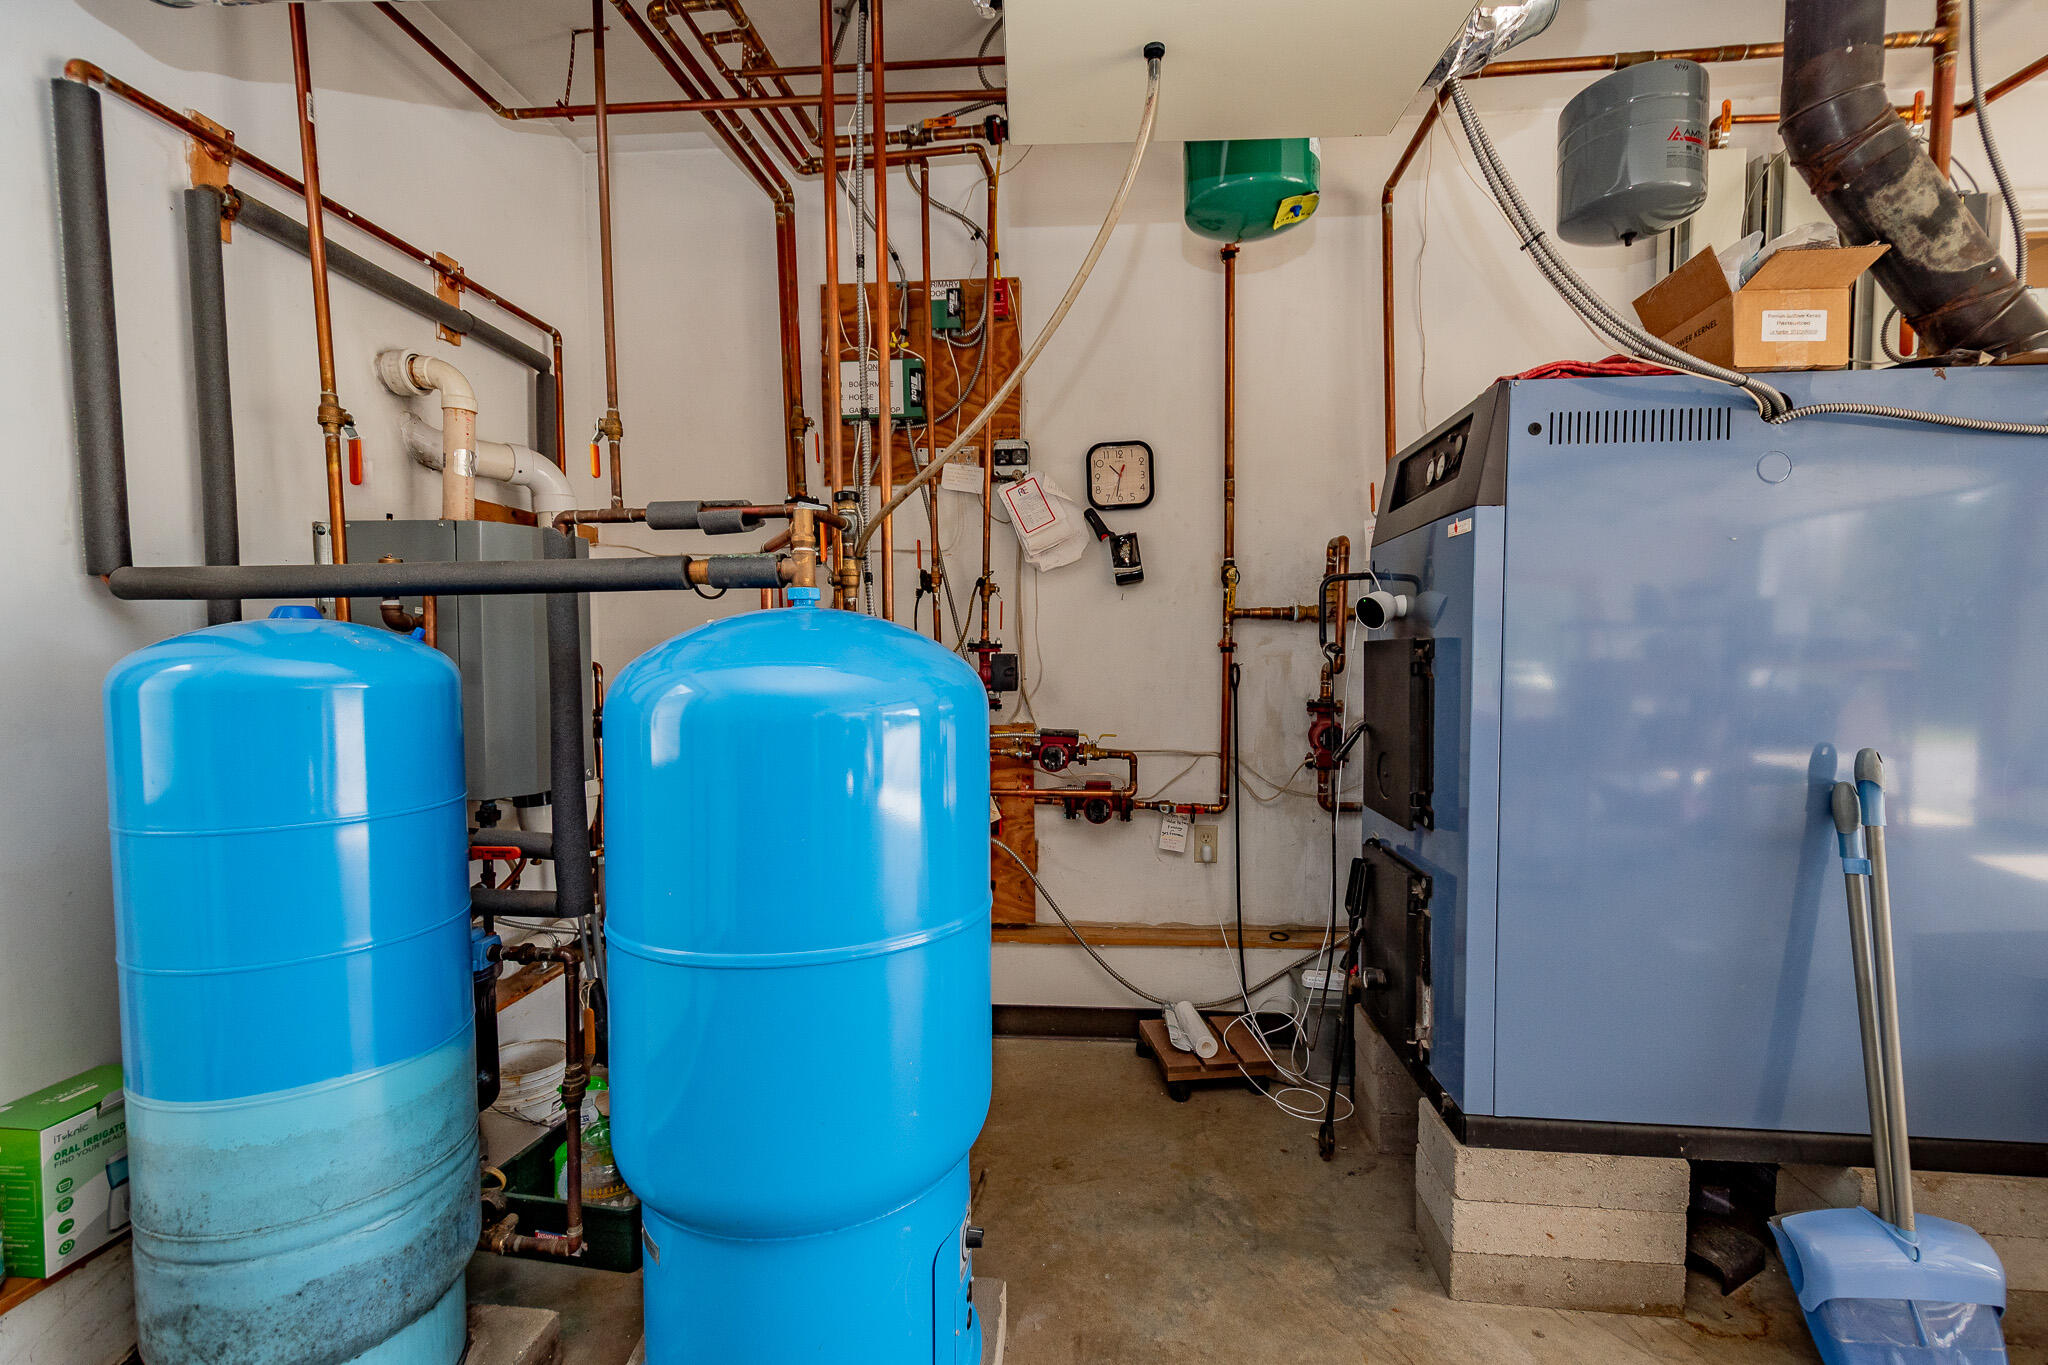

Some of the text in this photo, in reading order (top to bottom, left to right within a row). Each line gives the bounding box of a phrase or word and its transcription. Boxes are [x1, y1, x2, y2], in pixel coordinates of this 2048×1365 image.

[930, 280, 960, 289] RIMARY
[1693, 319, 1719, 338] KERNEL
[1103, 450, 1110, 459] 11
[1115, 449, 1124, 459] 12
[1130, 449, 1134, 458] 1
[1093, 459, 1104, 469] 10
[1138, 456, 1145, 466] 2
[1094, 472, 1101, 482] 9
[1140, 470, 1146, 479] 3
[1095, 485, 1102, 495] 8
[1139, 483, 1146, 491] 4
[1105, 493, 1111, 503] 7
[1117, 493, 1124, 502] 6
[1129, 492, 1136, 501] 5
[54, 1121, 126, 1161] ORAL IRRIGATO
[54, 1156, 75, 1169] FIND
[76, 1144, 101, 1157] YOUR
